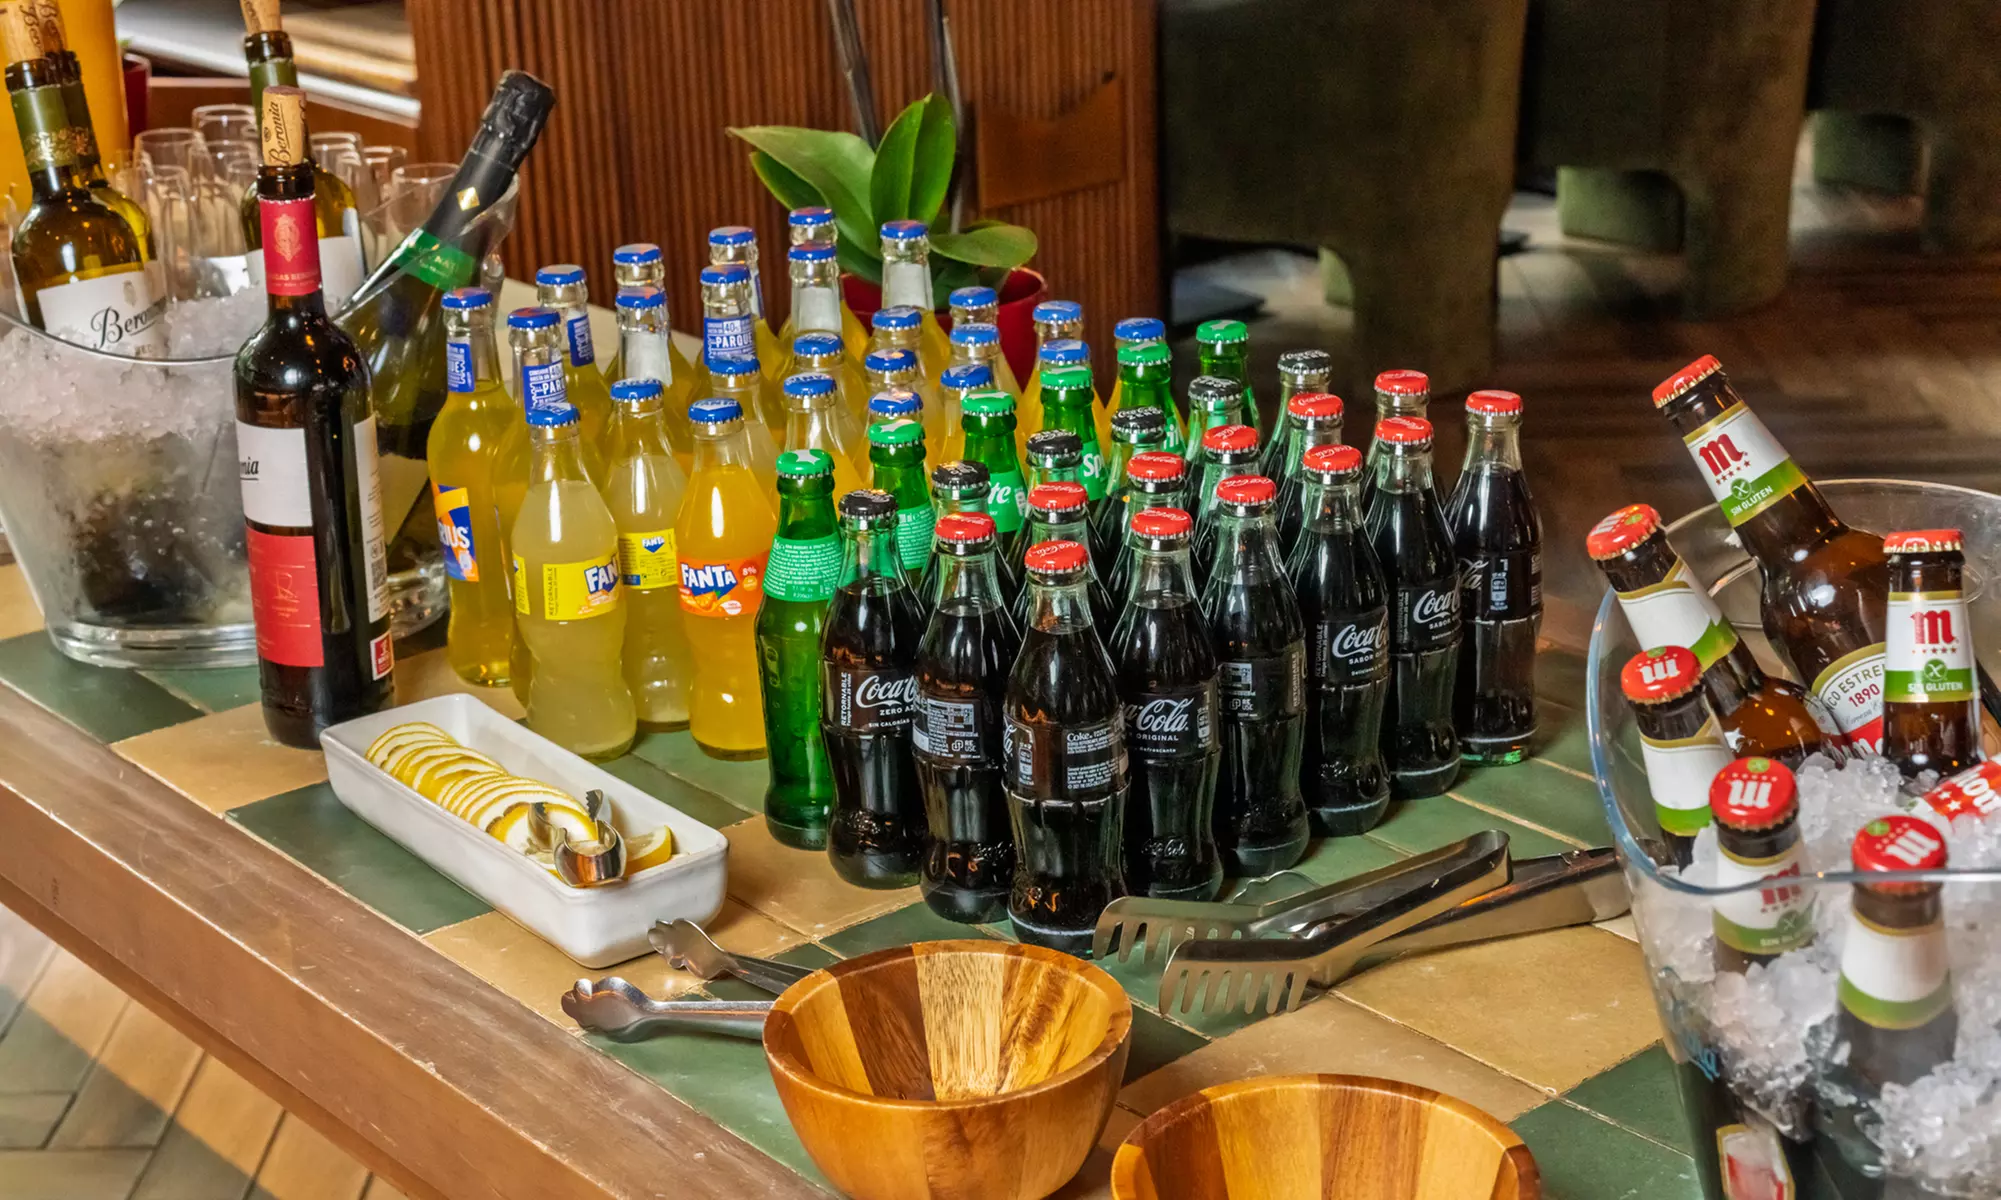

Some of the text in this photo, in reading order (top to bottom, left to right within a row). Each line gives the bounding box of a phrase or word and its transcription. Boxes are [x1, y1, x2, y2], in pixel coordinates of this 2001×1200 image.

[1741, 485, 1774, 510] GLUTEN
[680, 562, 738, 589] FANTA
[1848, 683, 1881, 708] 1890
[1926, 681, 1963, 692] GLUTEN
[880, 707, 903, 716] ZERO
[1136, 733, 1179, 741] ORIGINAL
